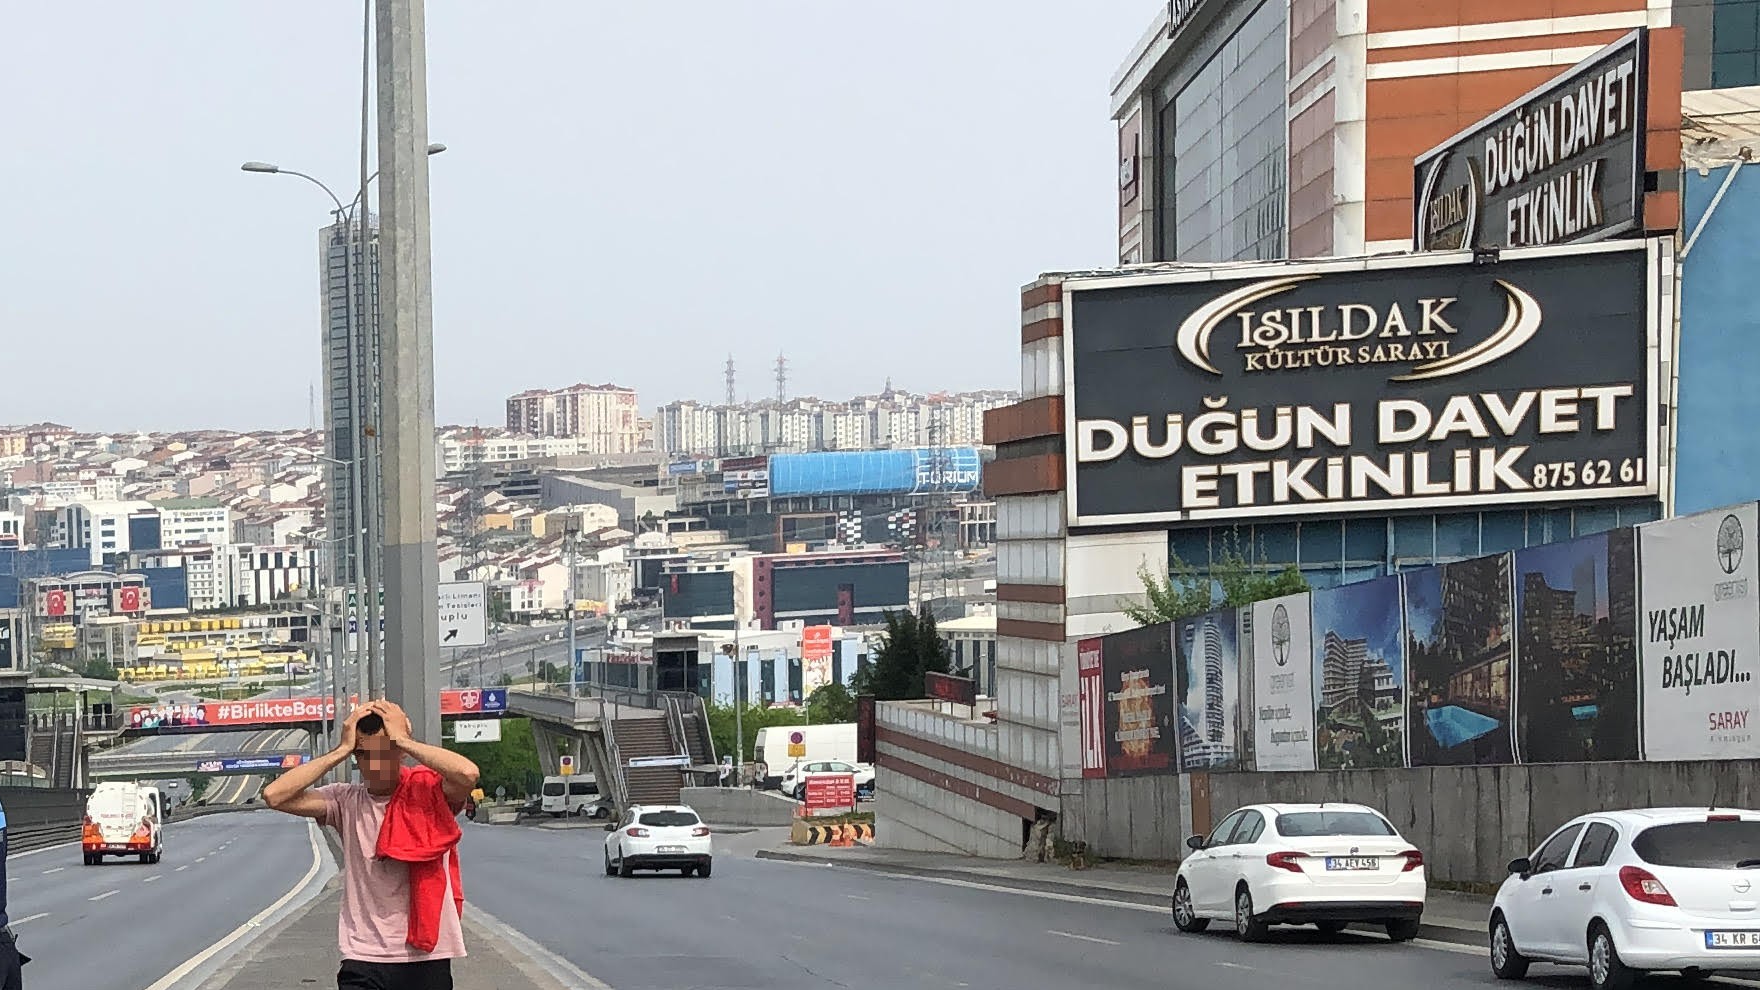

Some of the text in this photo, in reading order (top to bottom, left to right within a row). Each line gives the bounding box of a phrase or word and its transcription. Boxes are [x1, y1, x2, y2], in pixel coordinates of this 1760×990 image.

[1485, 59, 1633, 196] DÜĞÜN DAVET
[1237, 298, 1458, 351] IŞILDAK
[1245, 341, 1450, 371] KÜLTÜR SARAYI
[1077, 385, 1633, 462] DÜĞÜN DAVET
[1533, 462, 1576, 488] 875
[1582, 460, 1612, 485] 62
[1620, 458, 1643, 482] 61
[441, 612, 468, 622] uplu
[1649, 604, 1704, 650] YAŞAM
[1662, 649, 1751, 696] BAŞLADI...
[1080, 675, 1103, 769] İLK
[1709, 710, 1749, 730] SARAY
[1714, 933, 1760, 945] 34 KR 6
